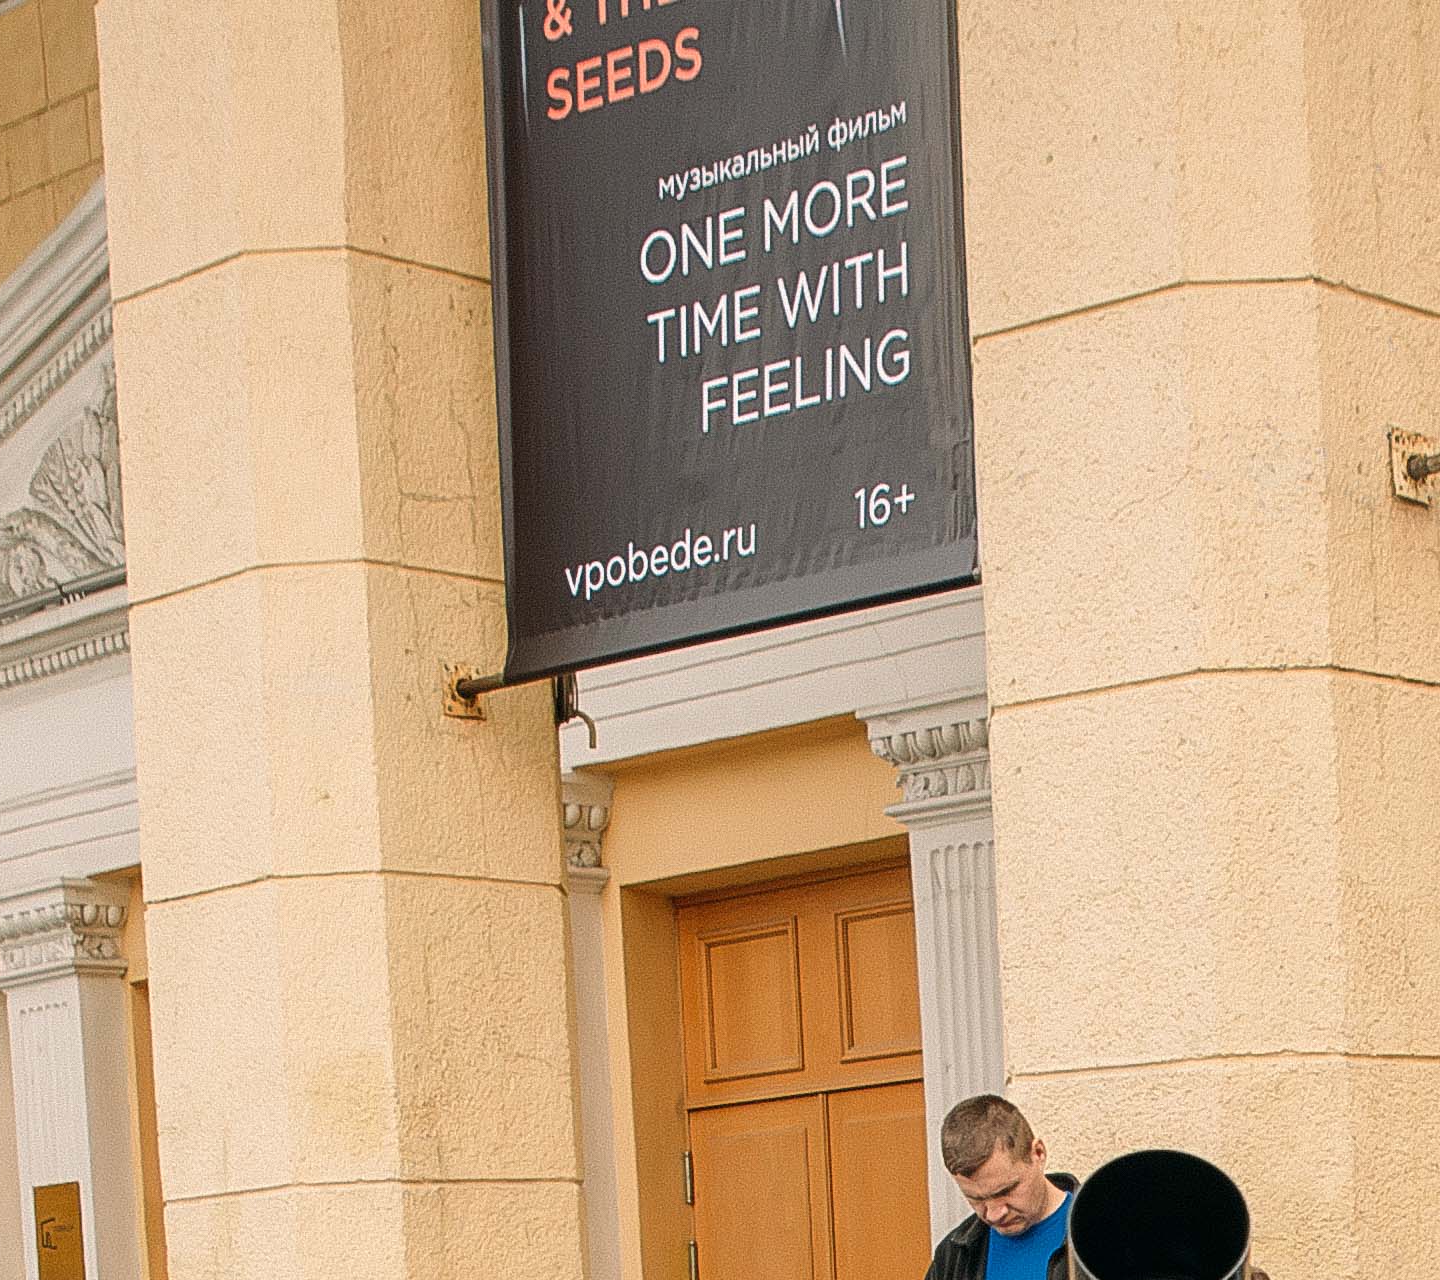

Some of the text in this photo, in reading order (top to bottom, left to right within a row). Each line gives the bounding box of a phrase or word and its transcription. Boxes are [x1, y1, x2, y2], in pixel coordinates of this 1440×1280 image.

[546, 26, 703, 120] SEEDS
[658, 100, 907, 200] музыкальный фильм
[640, 155, 909, 285] ONE MORE
[647, 242, 909, 363] TIME WITH
[701, 329, 911, 433] FEELING
[854, 481, 915, 529] 16+
[564, 522, 757, 600] vpobede.ru
